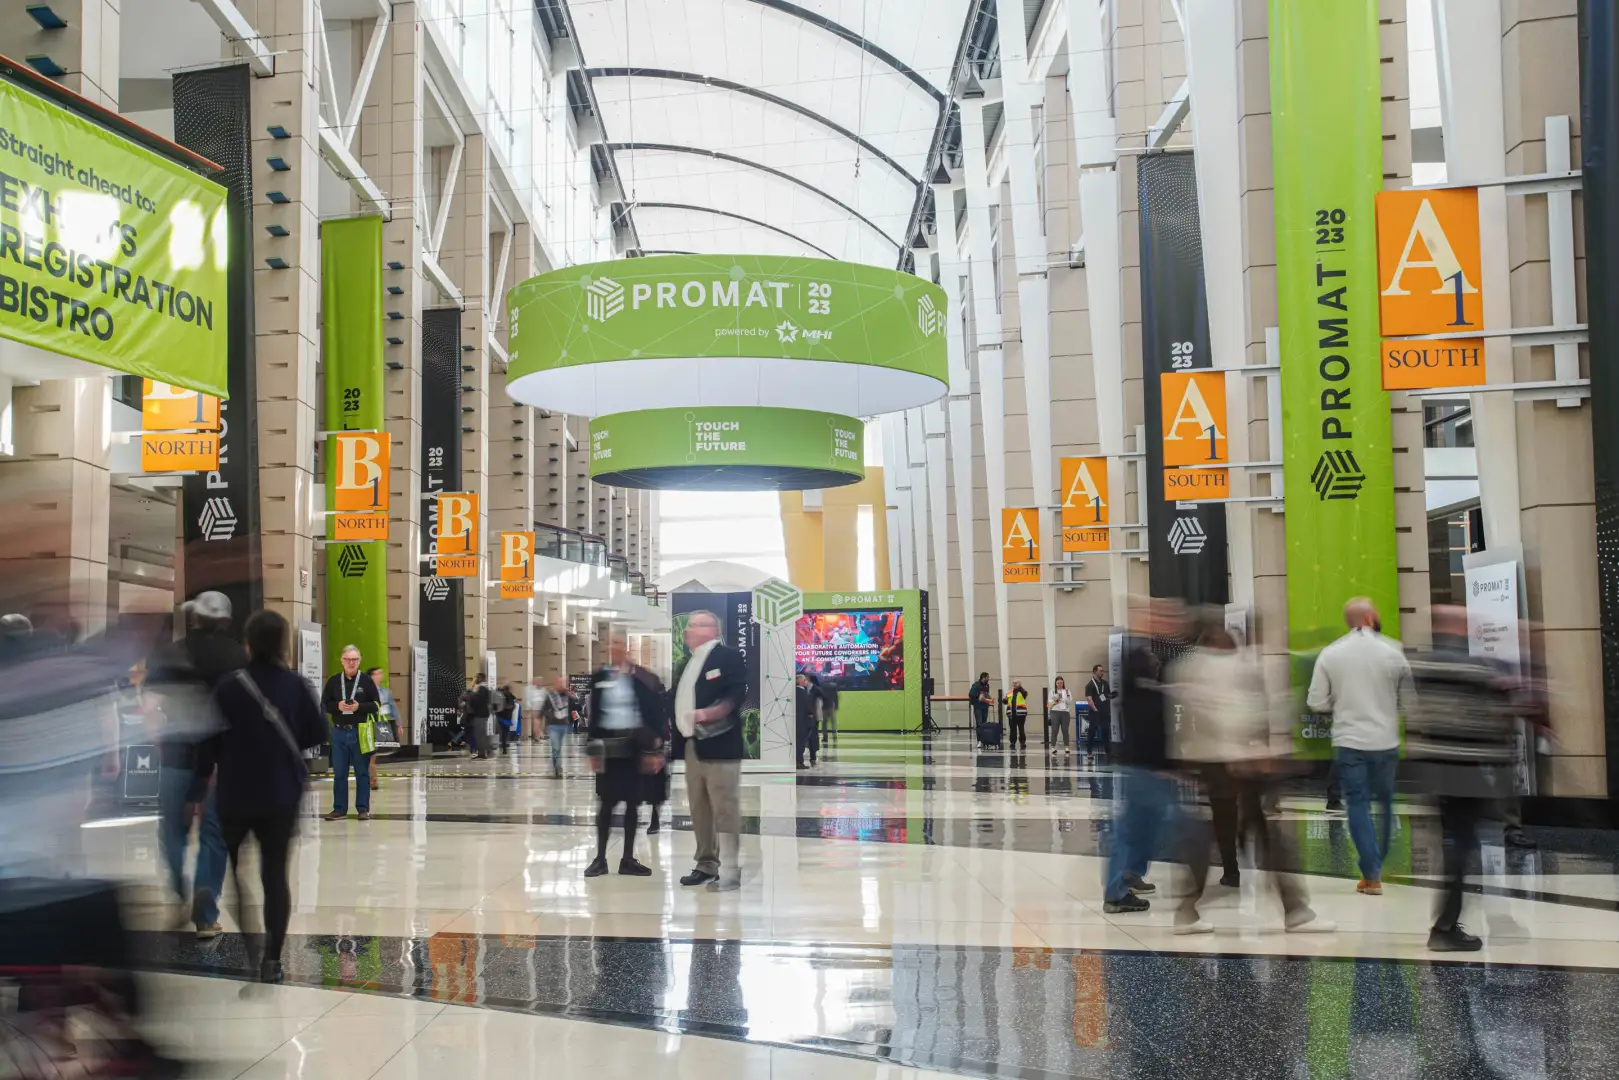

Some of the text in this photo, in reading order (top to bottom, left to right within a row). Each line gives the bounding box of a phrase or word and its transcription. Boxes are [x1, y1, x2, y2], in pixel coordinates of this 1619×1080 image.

[0, 127, 156, 214] Straight ahead to:
[1315, 208, 1346, 226] 20
[1315, 227, 1345, 245] 23
[0, 223, 213, 330] REGISTRATION
[632, 280, 790, 310] PROMAT
[808, 282, 832, 298] 20
[0, 274, 114, 341] BISTRO
[808, 299, 831, 315] 23
[715, 327, 756, 337] powered
[758, 327, 769, 338] by
[1171, 341, 1194, 355] 20
[1316, 262, 1353, 440] PROMAT
[1171, 355, 1193, 368] 23
[1388, 348, 1480, 369] SOUTH
[343, 388, 361, 399] 20
[343, 400, 360, 411] 23
[696, 422, 740, 431] TOUCH
[696, 432, 721, 441] THE
[834, 428, 856, 441] TOUCH
[145, 439, 213, 456] NORTH
[696, 442, 746, 452] FUTURE
[834, 438, 848, 448] THE
[428, 447, 444, 457] 20
[834, 447, 858, 460] FUTURE
[428, 457, 443, 467] 23
[1167, 473, 1226, 488] SOUTH
[337, 518, 385, 529] NORTH
[1064, 531, 1108, 543] SOUTH
[438, 559, 475, 569] NORTH
[1004, 567, 1040, 576] SOUTH
[502, 585, 533, 593] NORTH
[845, 595, 883, 604] PROMAT
